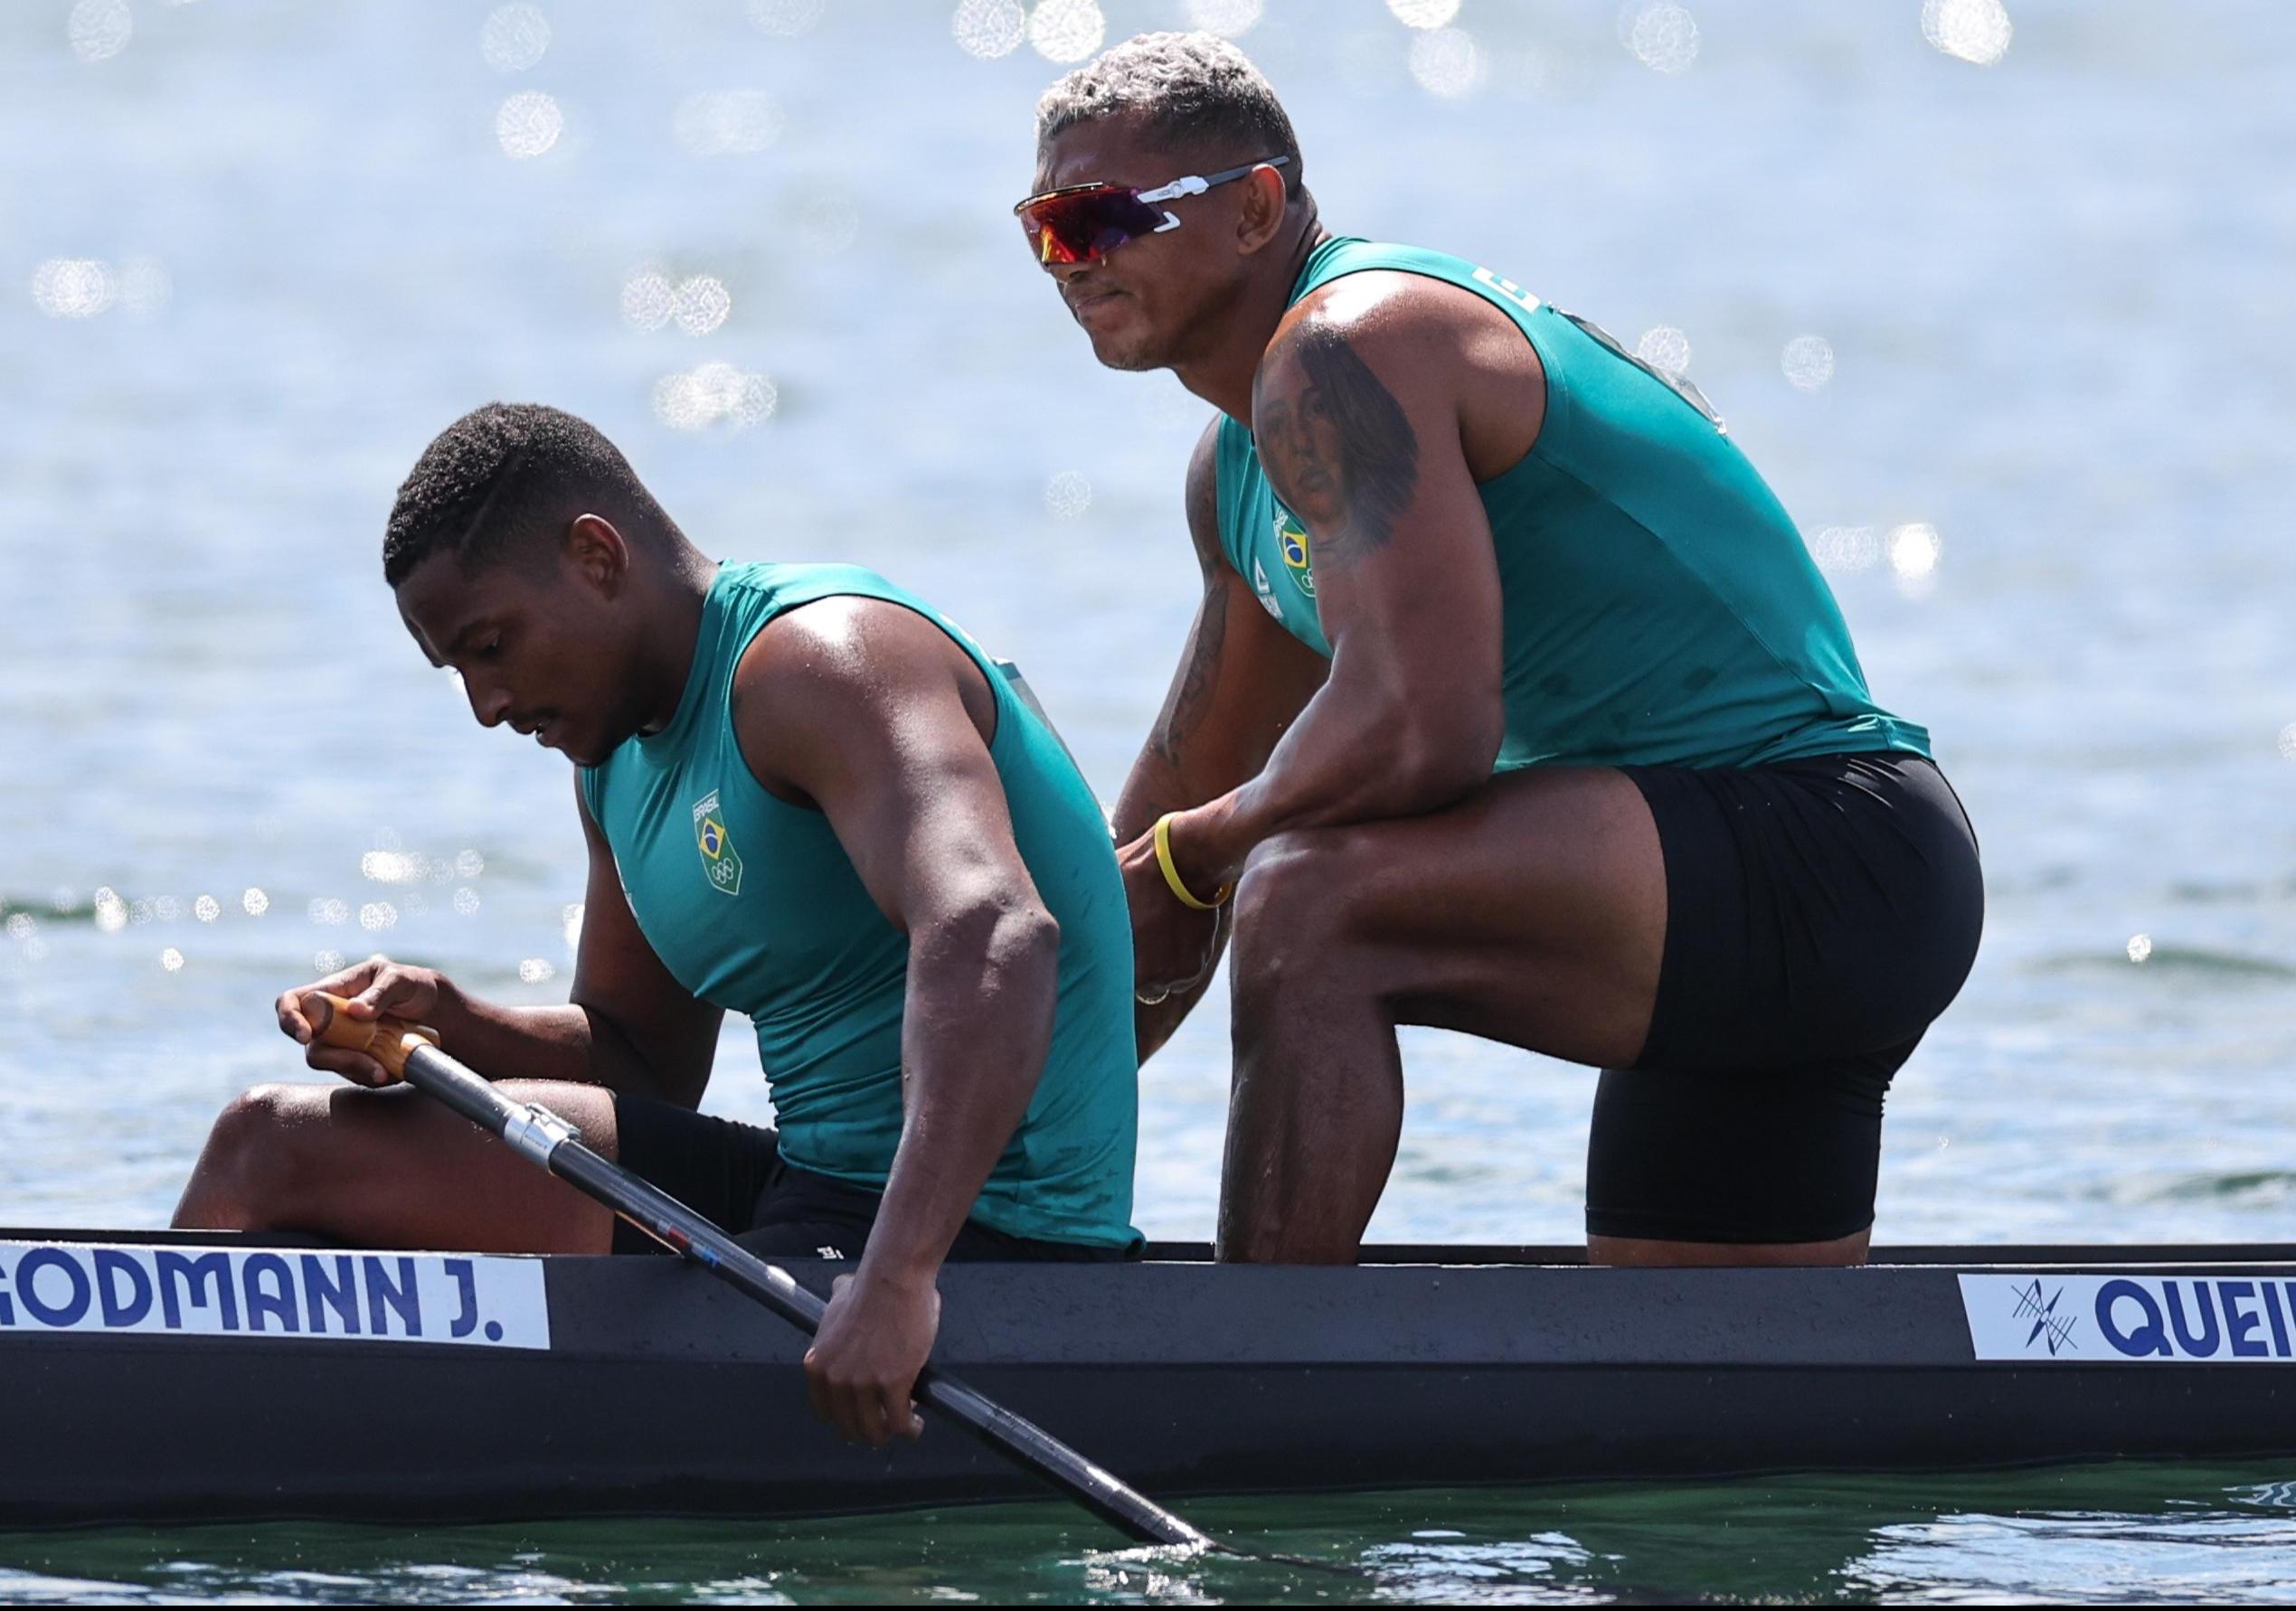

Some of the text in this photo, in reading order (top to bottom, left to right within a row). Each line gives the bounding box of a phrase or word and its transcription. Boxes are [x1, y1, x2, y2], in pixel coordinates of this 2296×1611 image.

[0, 1248, 504, 1342] ODMANN J.
[2094, 1279, 2296, 1358] QUEI
